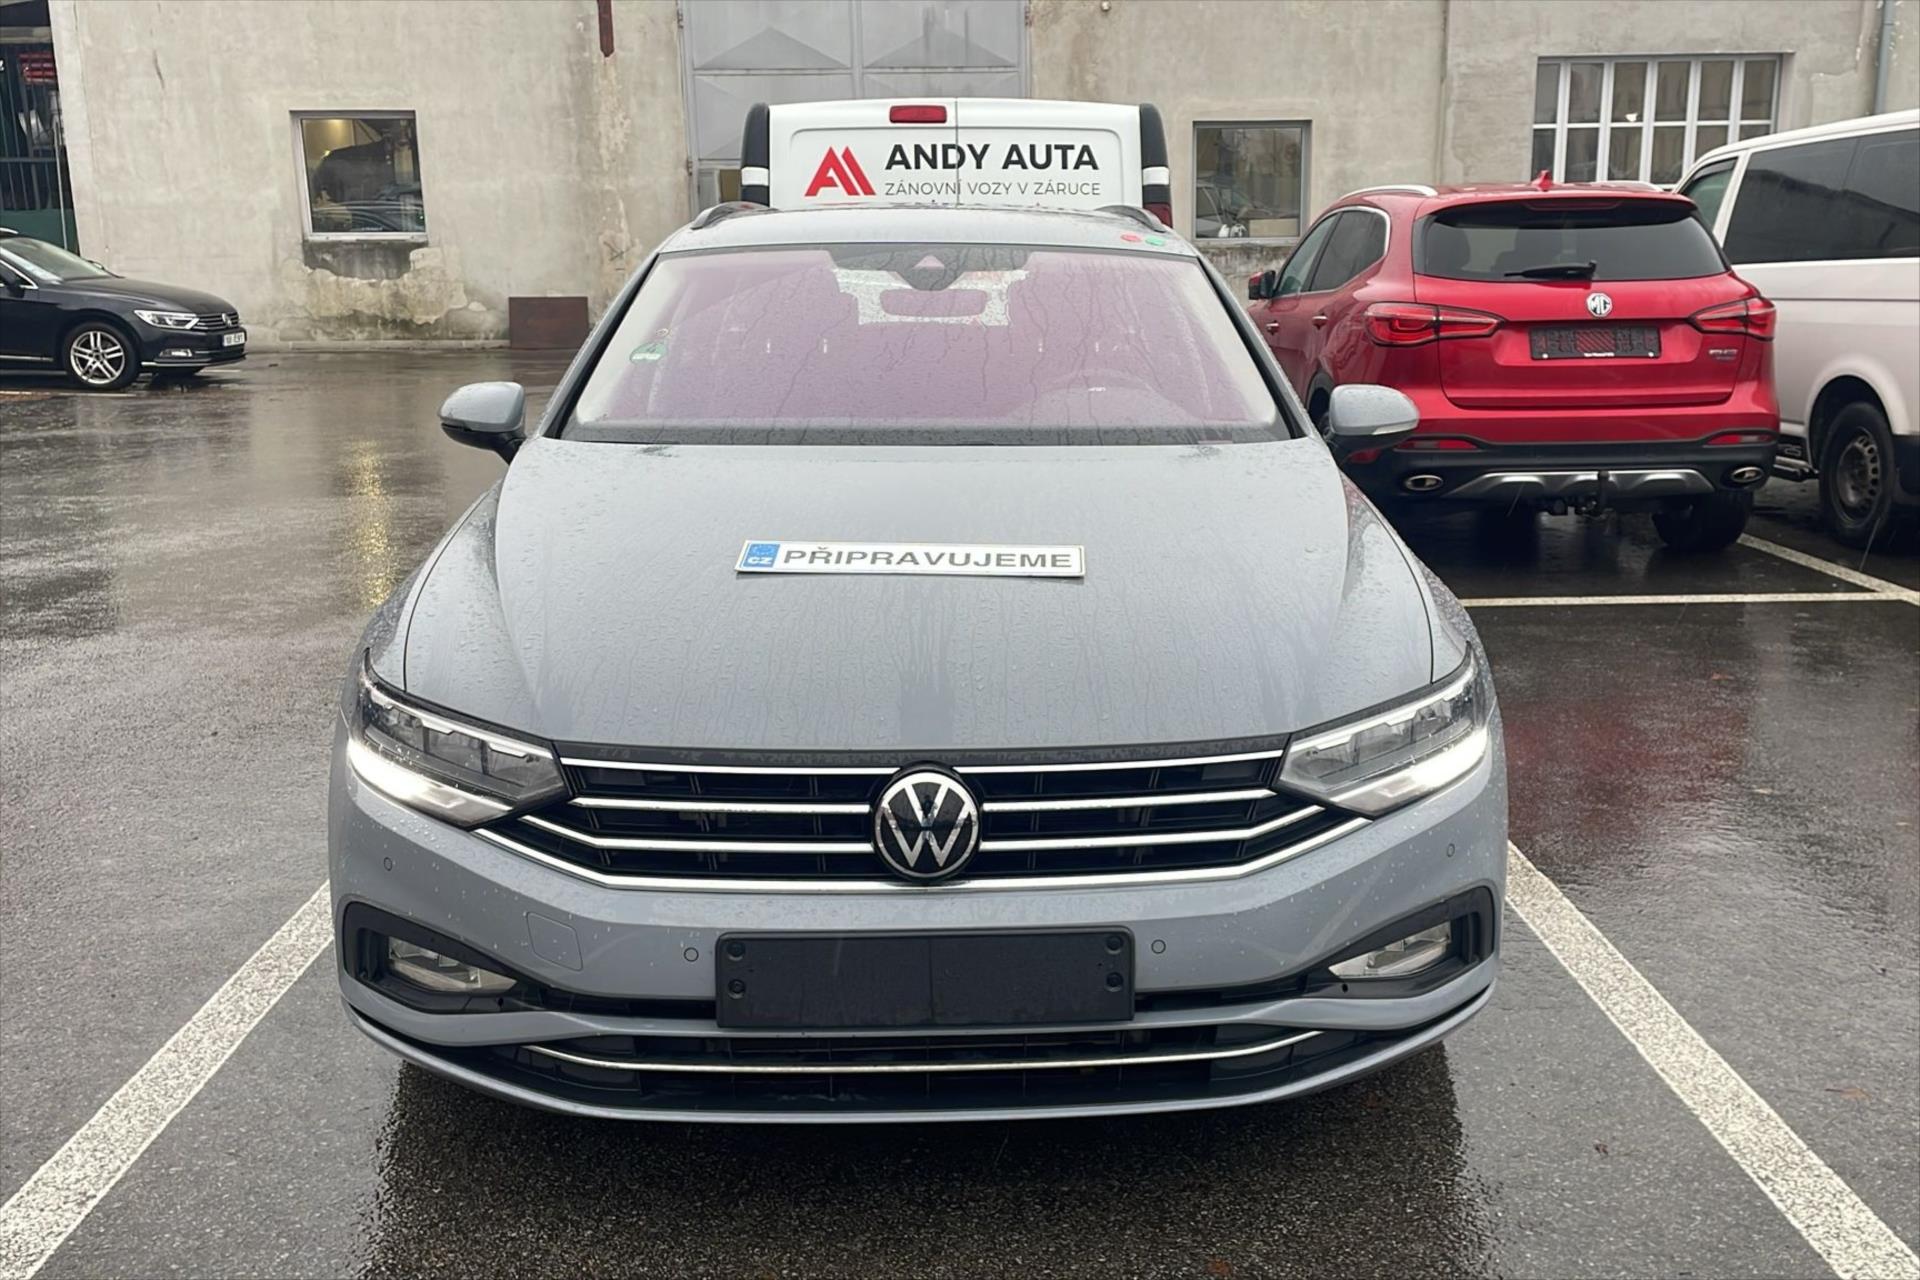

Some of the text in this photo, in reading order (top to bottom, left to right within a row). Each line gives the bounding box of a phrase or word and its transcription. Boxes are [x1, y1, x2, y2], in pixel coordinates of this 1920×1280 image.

[885, 144, 1100, 170] ANDY AUTA
[885, 178, 1101, 196] ZÁNOVNÍ VOZY V ZÁRUCE
[783, 546, 1073, 569] PŘIPRAVUJEME
